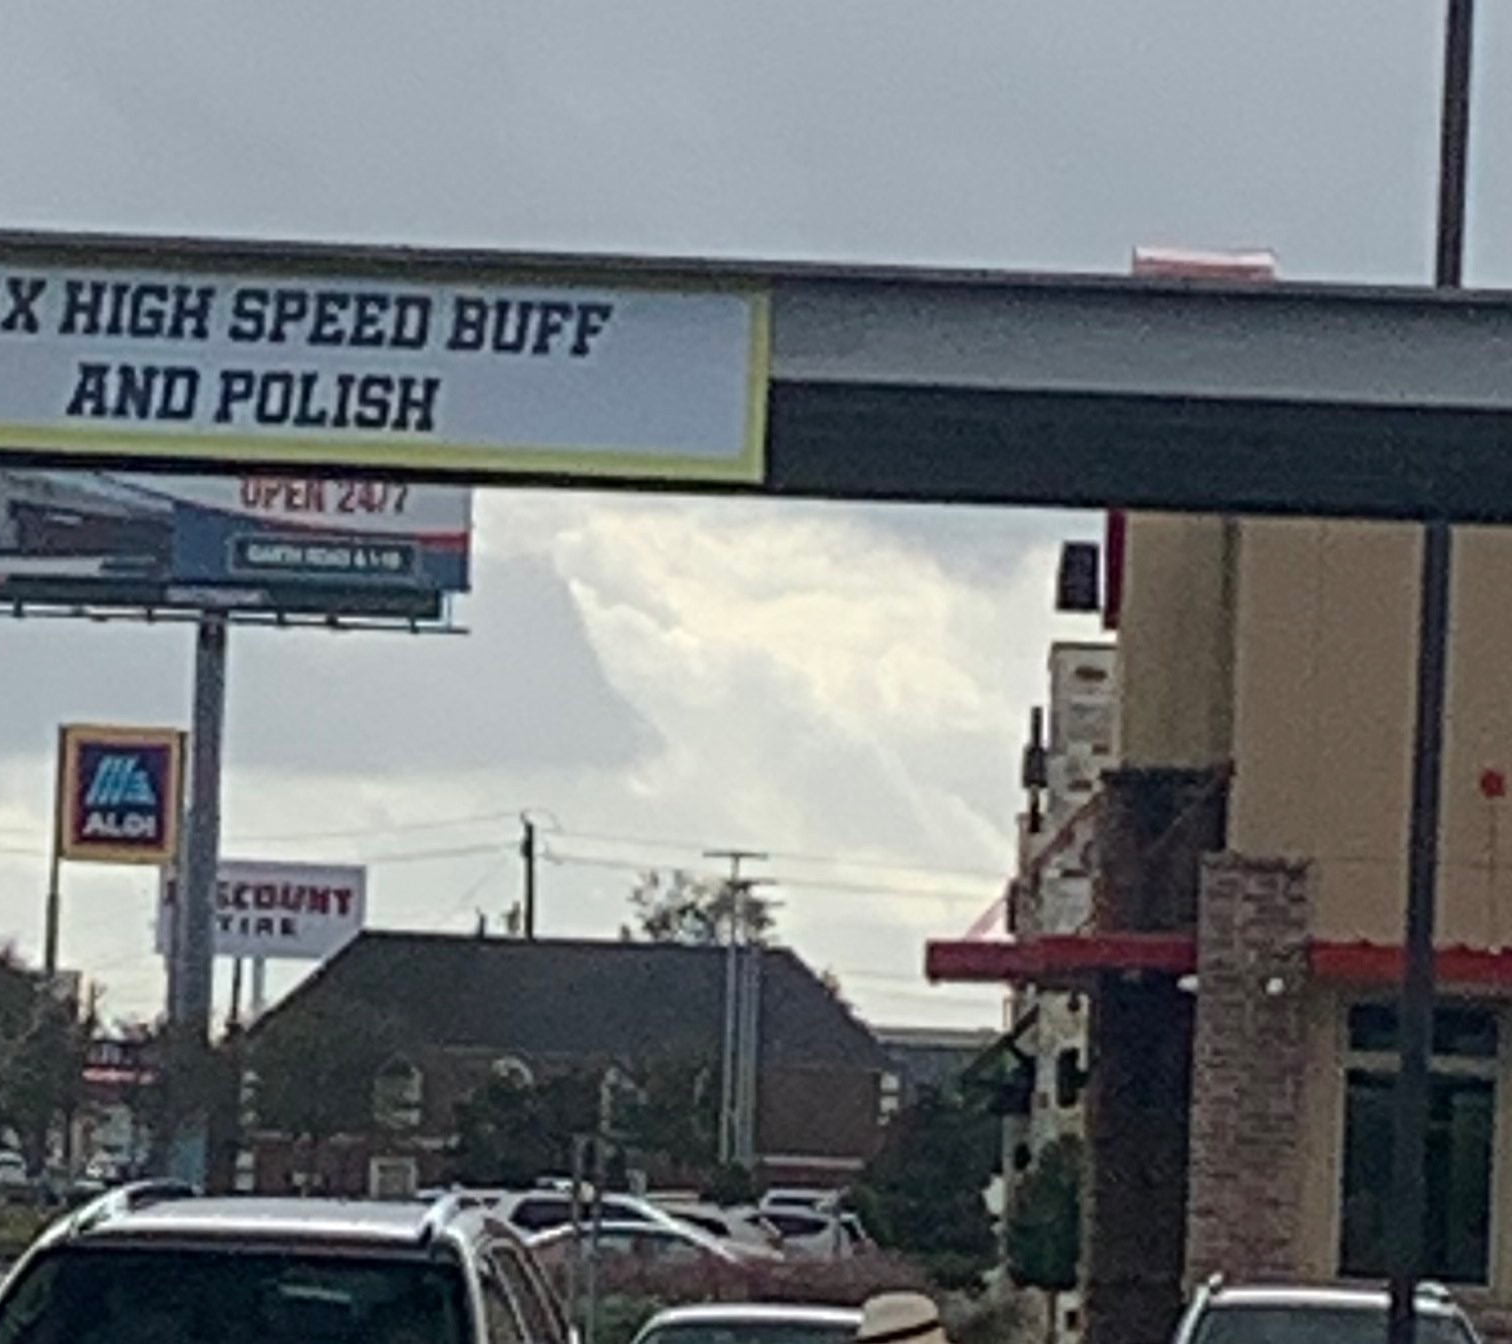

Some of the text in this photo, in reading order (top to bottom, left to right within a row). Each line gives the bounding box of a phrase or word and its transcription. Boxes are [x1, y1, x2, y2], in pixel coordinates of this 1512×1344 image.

[58, 280, 216, 343] HIGH
[228, 287, 436, 354] SPEED
[445, 295, 614, 357] BUFF
[66, 361, 442, 433] AND POLISH
[241, 477, 324, 512] OPEN
[82, 811, 158, 838] ALDI
[216, 916, 299, 936] TIRE
